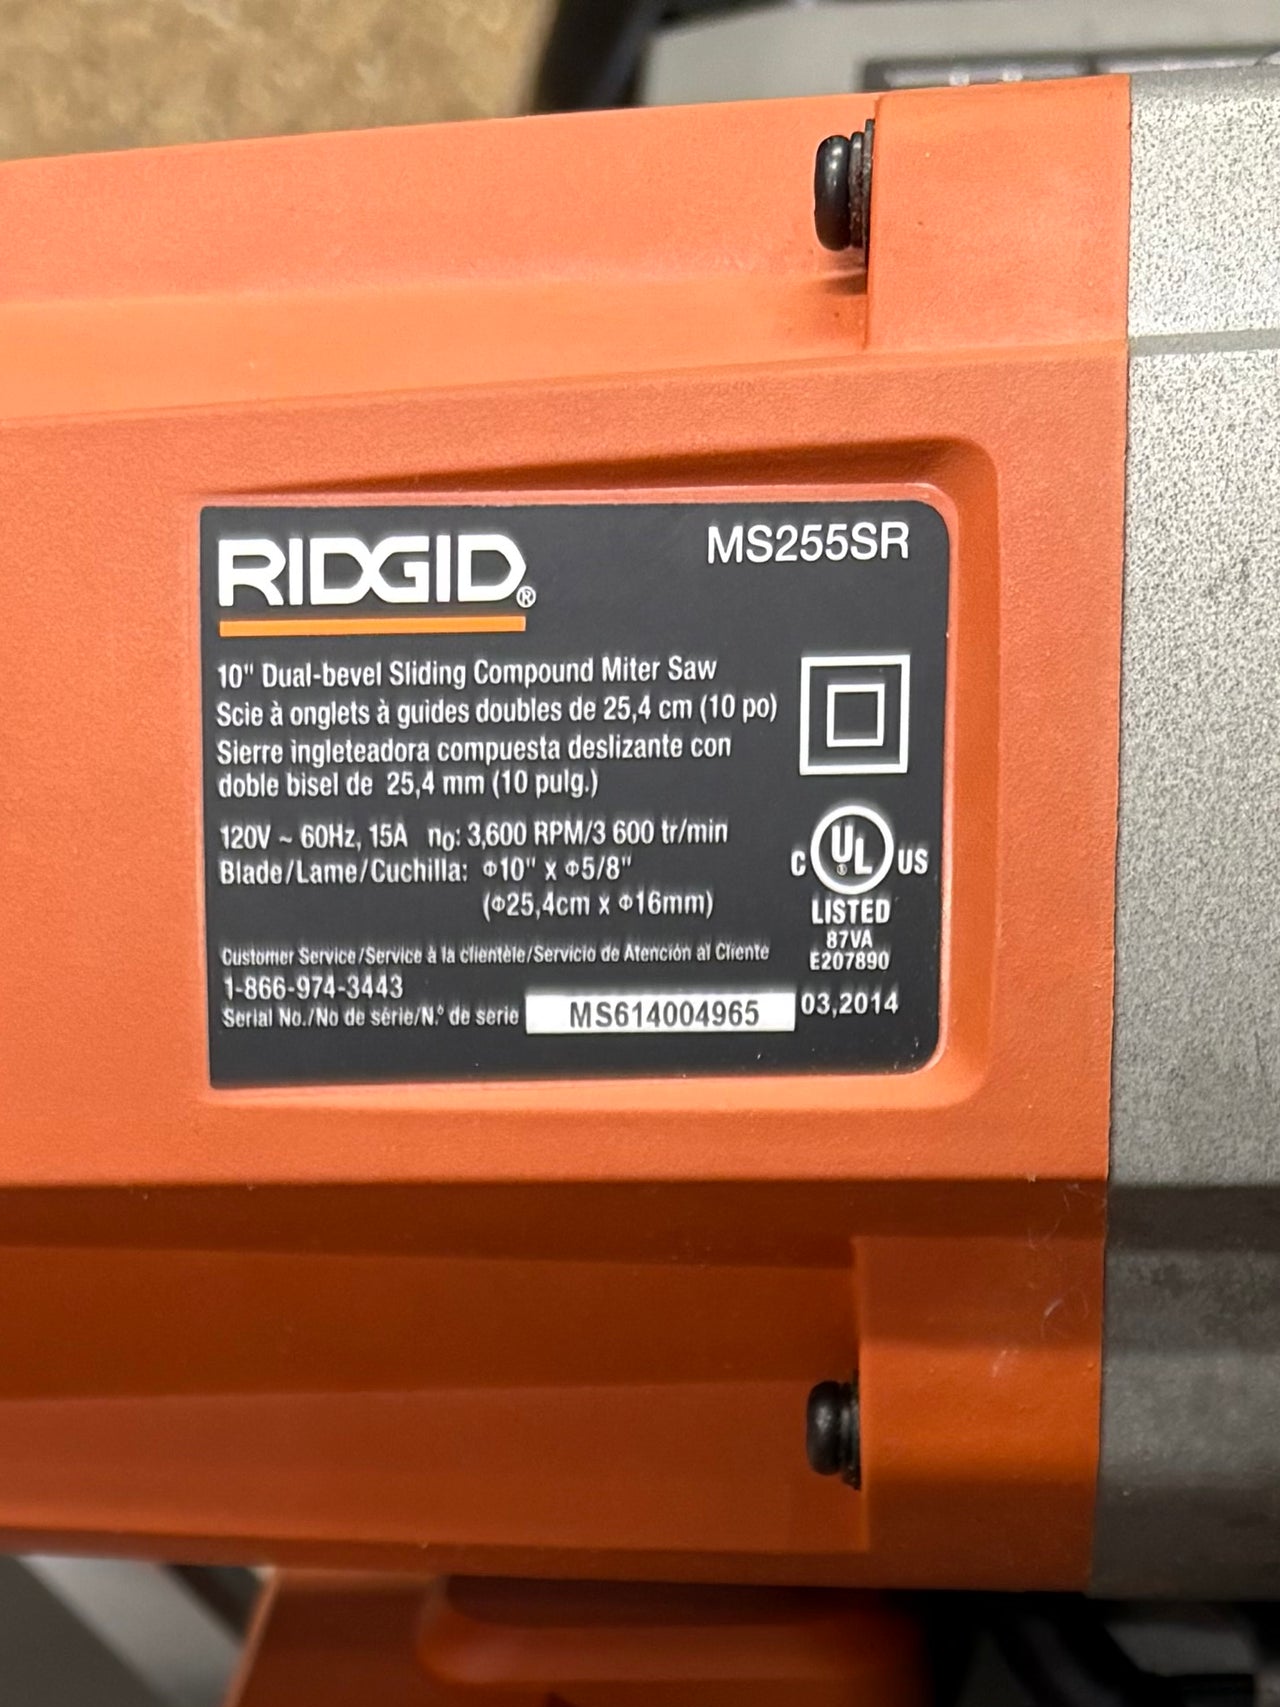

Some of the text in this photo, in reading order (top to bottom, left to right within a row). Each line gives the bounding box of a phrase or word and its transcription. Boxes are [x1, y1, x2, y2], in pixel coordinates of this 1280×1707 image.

[707, 521, 910, 564] MS255SR
[217, 655, 717, 690] 10" Dual-bevel Sliding Compound Miter Saw
[216, 692, 778, 730] Scie à onglets à guides doubles de 25,4 cm (10 po)
[217, 733, 732, 768] Sierre ingleteadora compuesta deslizante con
[218, 768, 599, 799] doble bisel de 25,4 mm (10 pulg.)
[219, 824, 271, 849] 120V
[300, 823, 362, 852] 60Hz,
[369, 823, 408, 849] 15A
[467, 821, 527, 850] 3,600
[533, 819, 606, 846] RPM/3
[613, 819, 655, 845] 600
[661, 817, 729, 845] tr/min
[219, 859, 468, 884] Blade/Lame/Cuchilla:
[545, 862, 557, 880] x
[598, 896, 610, 915] x
[812, 899, 891, 925] LISTED
[826, 929, 873, 949] 87VA
[221, 947, 294, 967] Customer
[298, 945, 422, 965] Service/Service
[427, 945, 438, 964] à
[442, 945, 456, 964] la
[601, 944, 620, 962] de
[624, 940, 691, 962] Atención
[696, 941, 711, 961] al
[715, 940, 770, 961] Cliente
[810, 951, 889, 971] E207890
[223, 973, 404, 1000] 1-866-974-3443
[222, 1006, 273, 1028] Serial
[279, 1007, 339, 1027] No./No
[345, 1006, 365, 1026] de
[449, 1004, 470, 1025] de
[475, 1005, 519, 1025] serie
[569, 999, 760, 1028] MS614004965
[800, 992, 899, 1018] 03,2014
